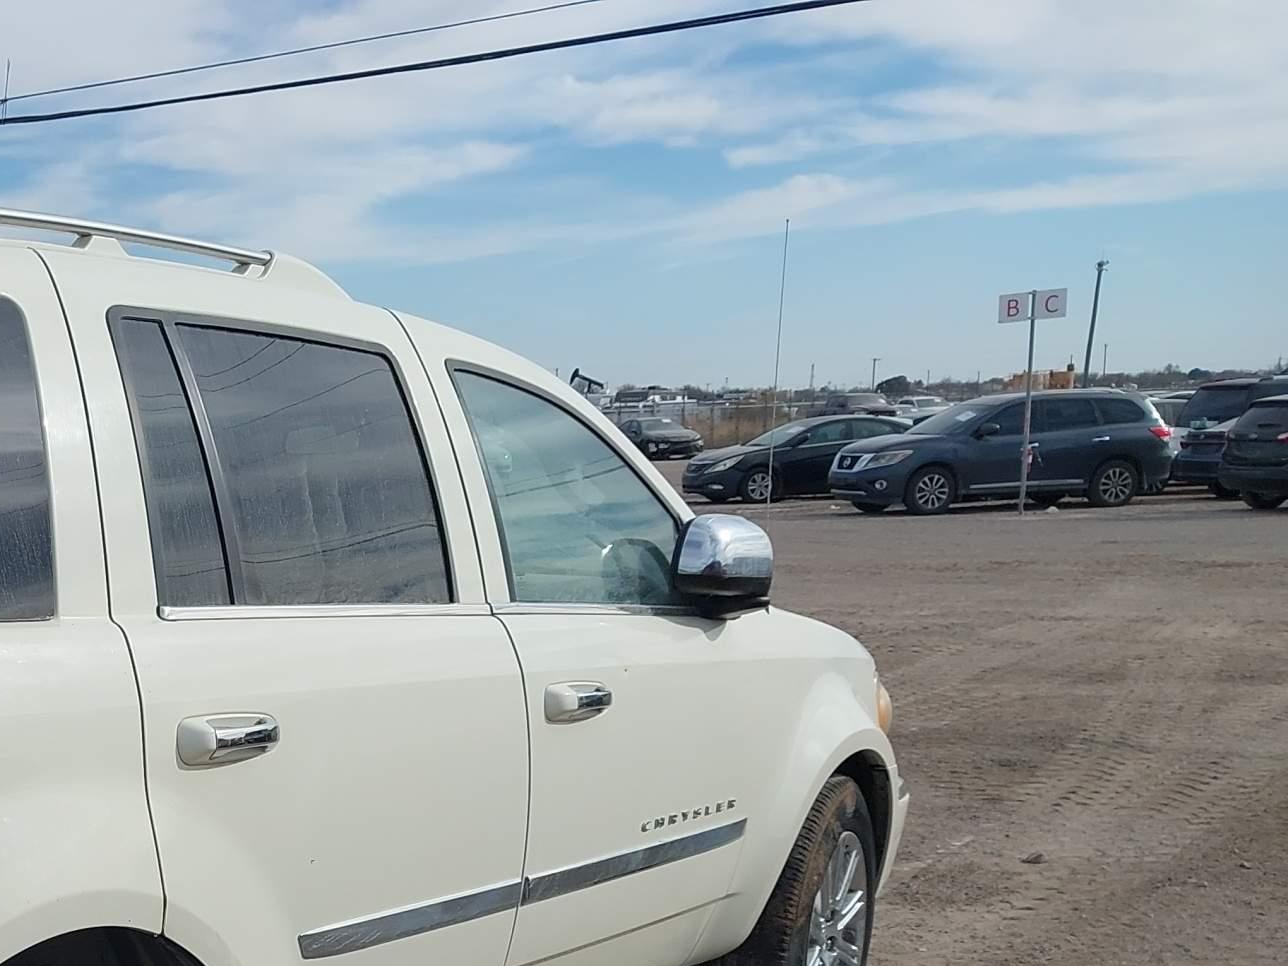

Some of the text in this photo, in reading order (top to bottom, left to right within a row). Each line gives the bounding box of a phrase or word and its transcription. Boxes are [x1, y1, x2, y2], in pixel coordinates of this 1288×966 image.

[1007, 299, 1020, 317] B
[1044, 294, 1059, 313] C
[640, 798, 737, 833] CHRYSLER
